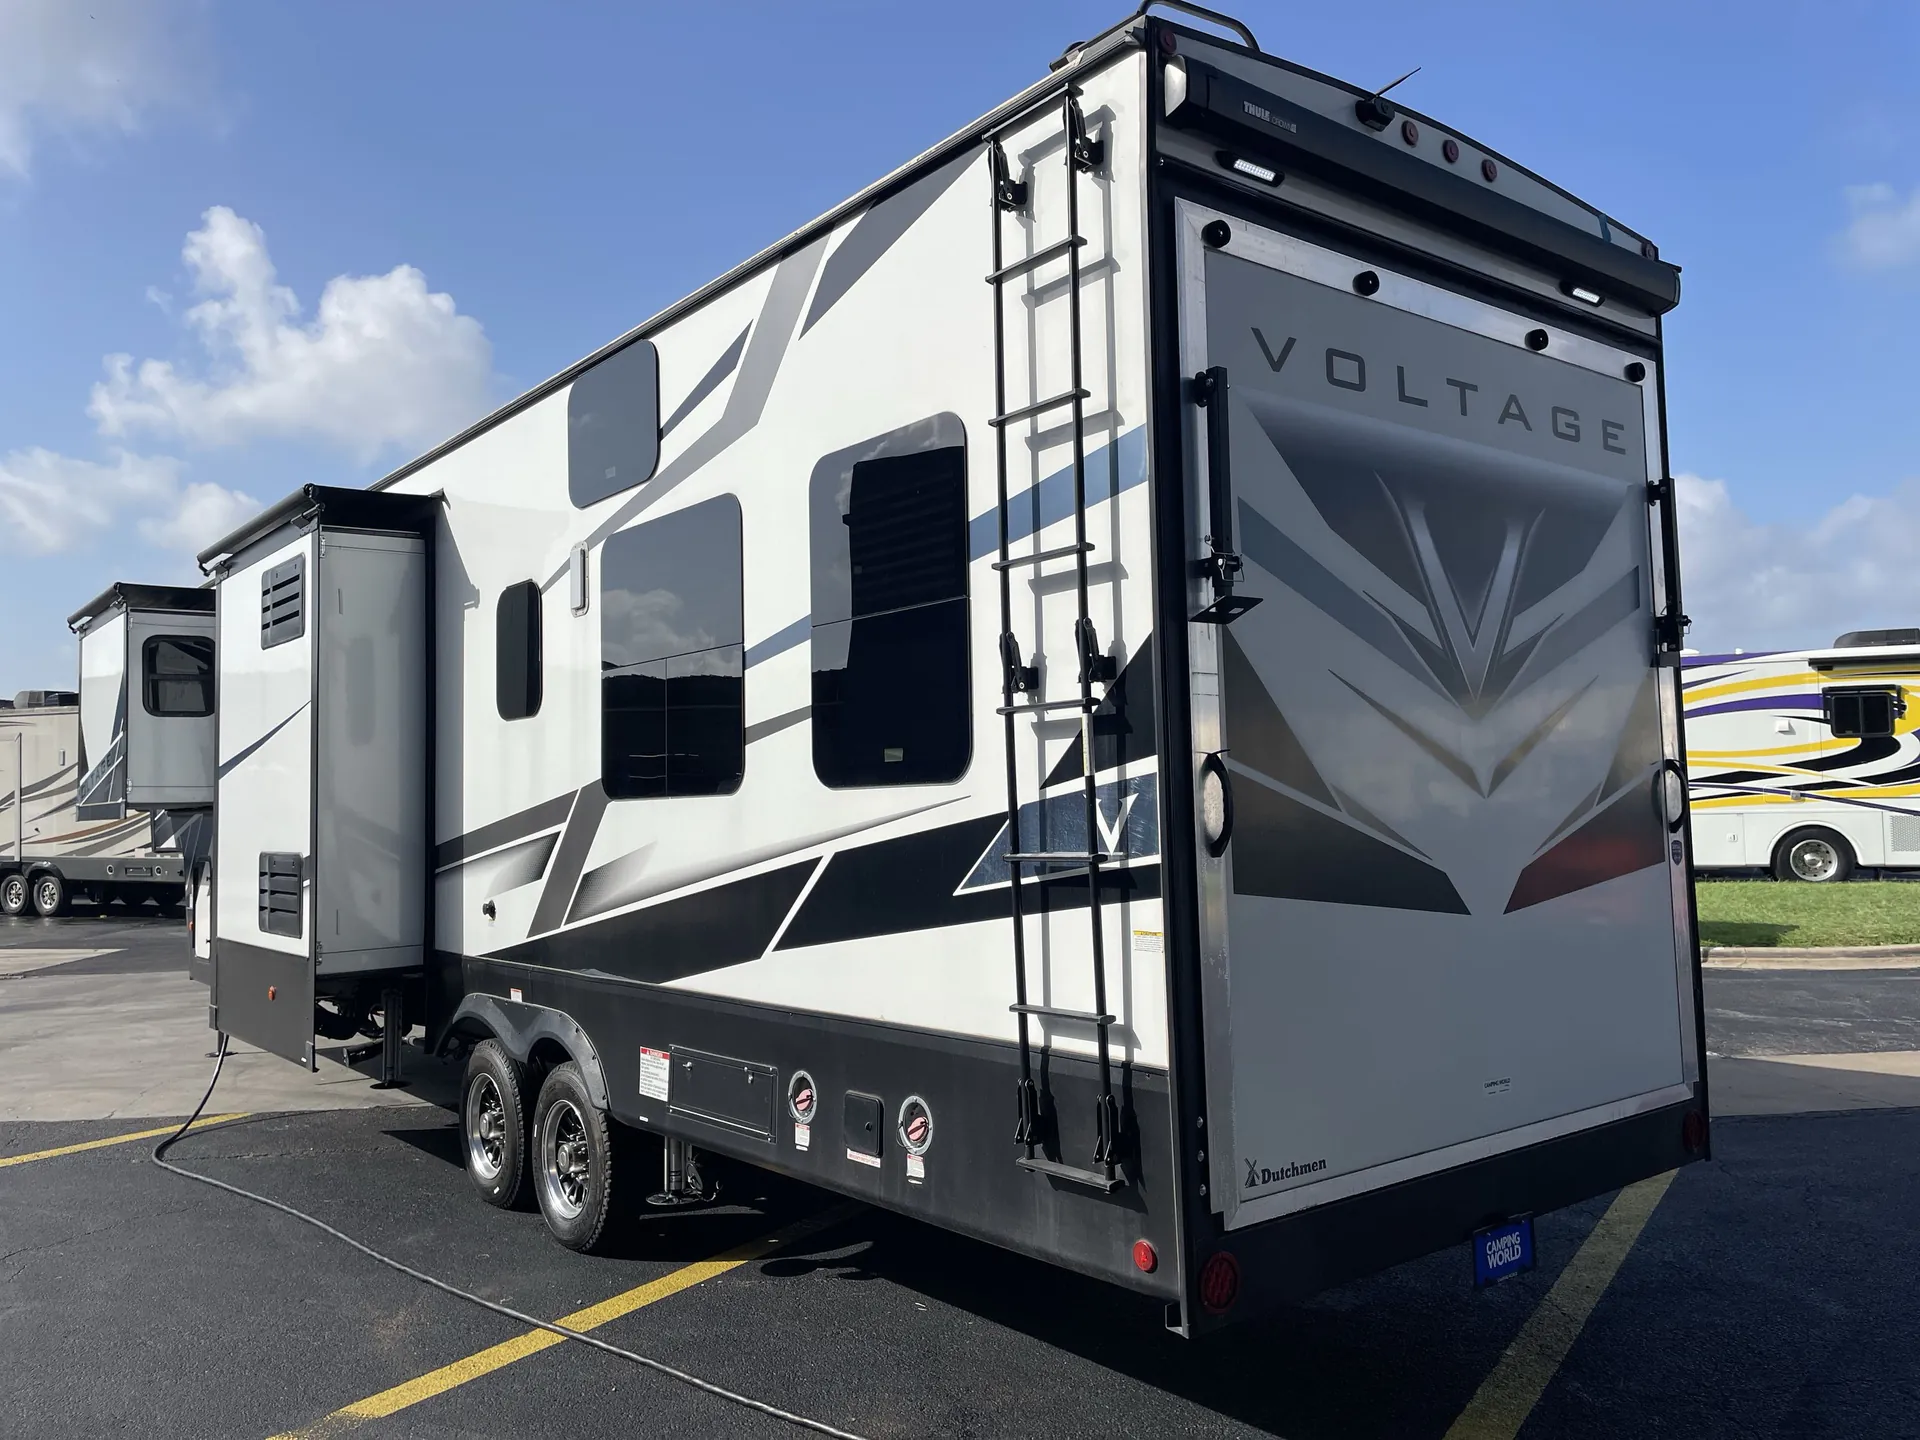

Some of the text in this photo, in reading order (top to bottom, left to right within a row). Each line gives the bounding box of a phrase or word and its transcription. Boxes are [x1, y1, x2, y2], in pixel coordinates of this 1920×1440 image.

[1243, 100, 1271, 122] THULE
[1250, 327, 1626, 455] VOLTAGE
[1261, 1159, 1327, 1185] Dutchmen
[1486, 1231, 1521, 1255] CAMPING
[1487, 1244, 1521, 1269] WORLD
